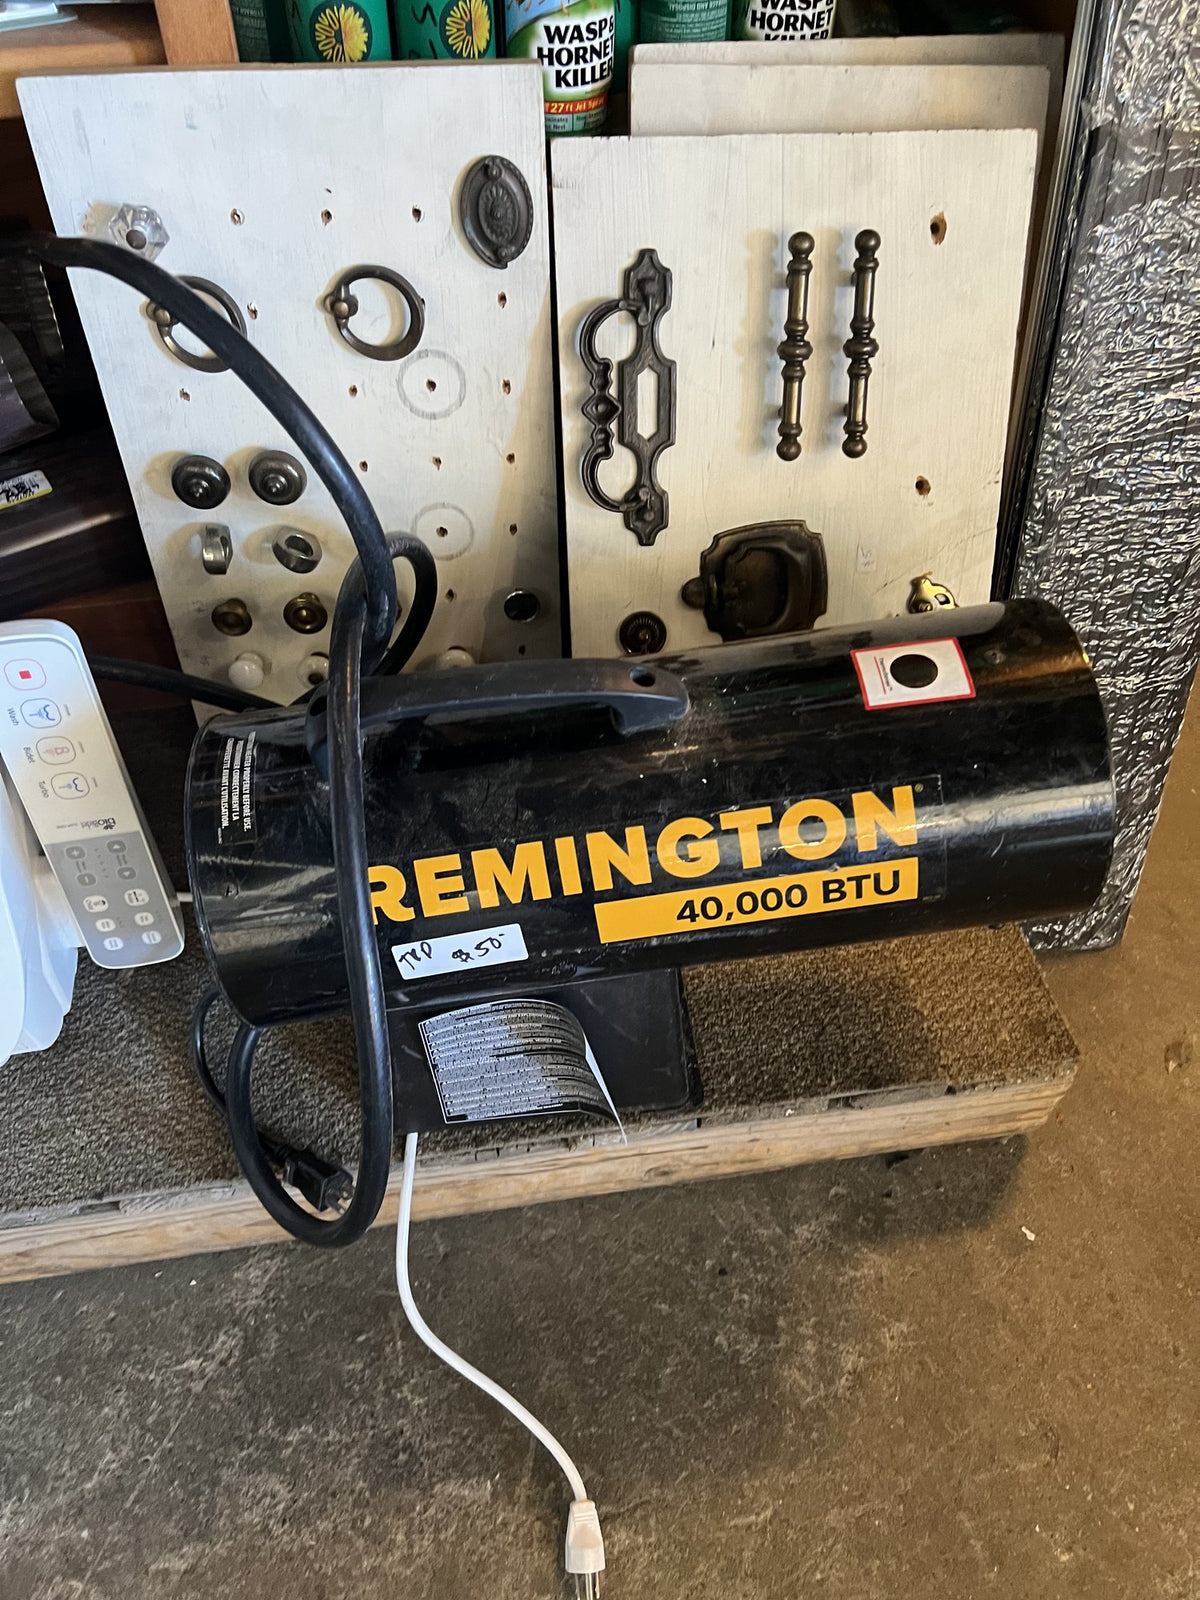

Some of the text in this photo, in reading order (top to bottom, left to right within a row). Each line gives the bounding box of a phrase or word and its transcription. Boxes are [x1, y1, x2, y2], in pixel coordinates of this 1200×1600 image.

[750, 7, 833, 31] HORNET
[537, 34, 614, 67] HORNET
[555, 57, 613, 88] KILLER
[7, 707, 19, 727] Wash
[23, 746, 36, 764] Bidet
[38, 780, 50, 799] Turbo
[242, 794, 251, 817] BEFORE
[367, 785, 918, 925] REMINGTON
[676, 870, 900, 923] 40,000 BTU
